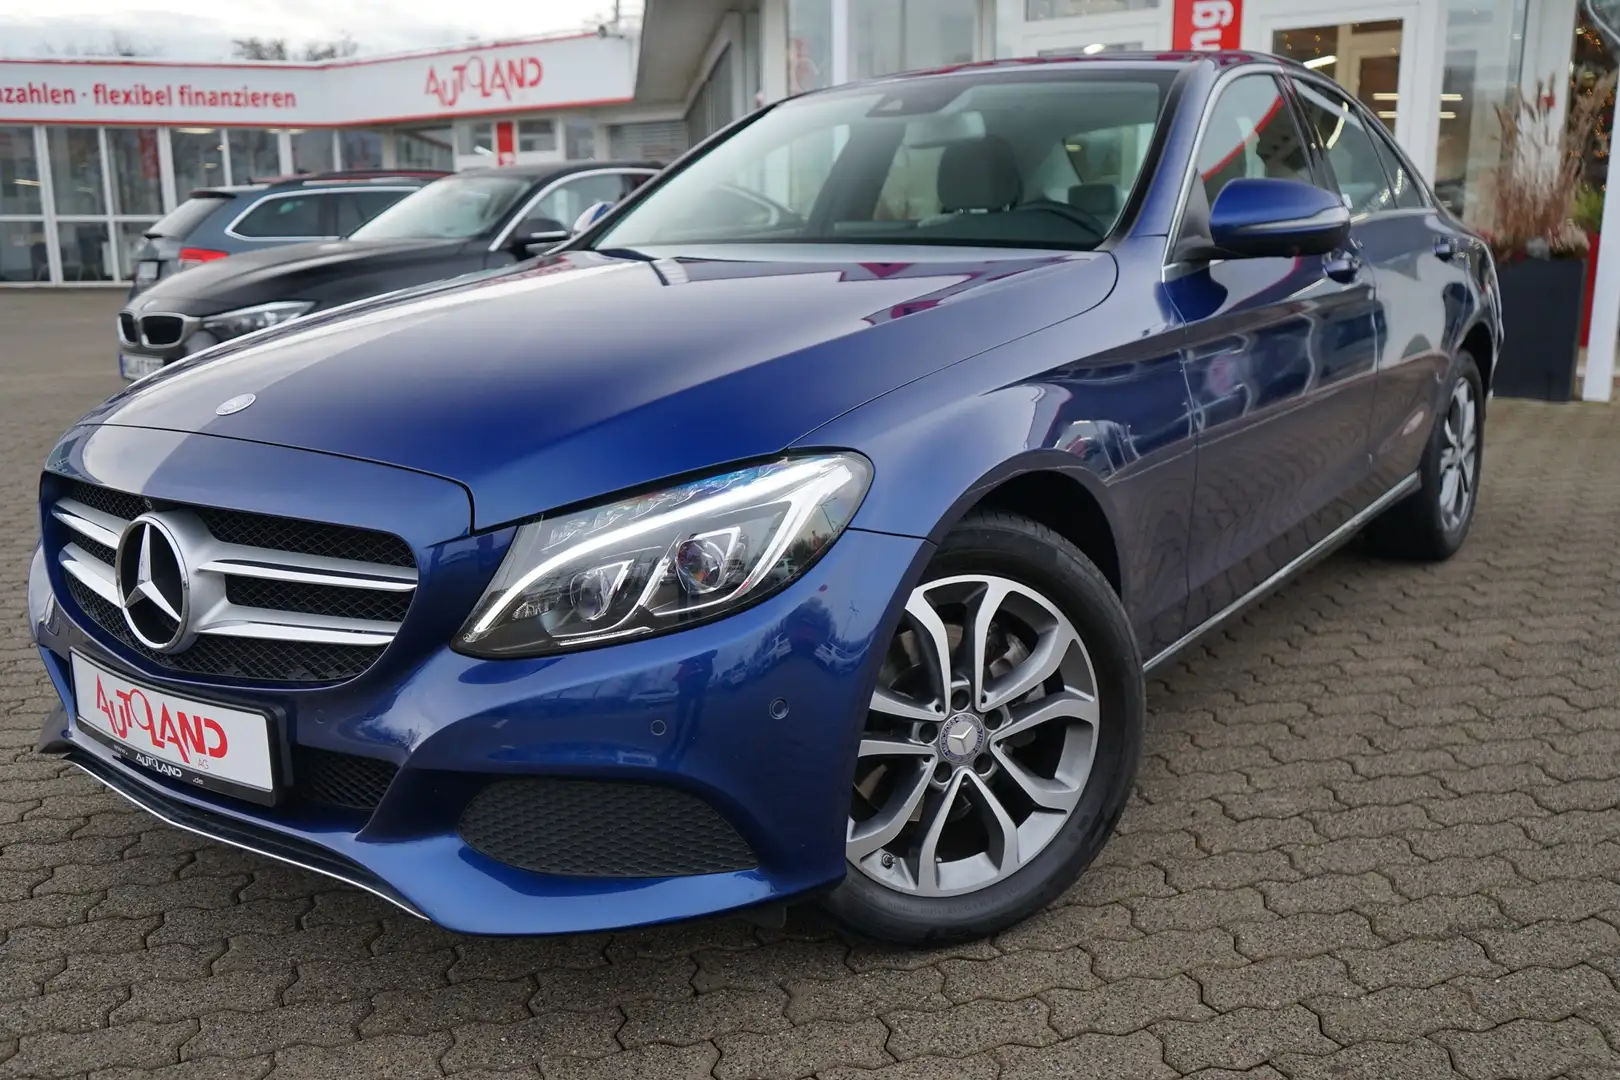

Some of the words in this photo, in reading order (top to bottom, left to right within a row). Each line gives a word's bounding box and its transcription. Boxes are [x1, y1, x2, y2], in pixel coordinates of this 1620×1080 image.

[0, 83, 76, 105] zahlen
[93, 83, 172, 107] flexibel
[178, 85, 296, 109] finanzieren
[96, 673, 228, 764] AUTOLAND
[197, 758, 209, 770] AG
